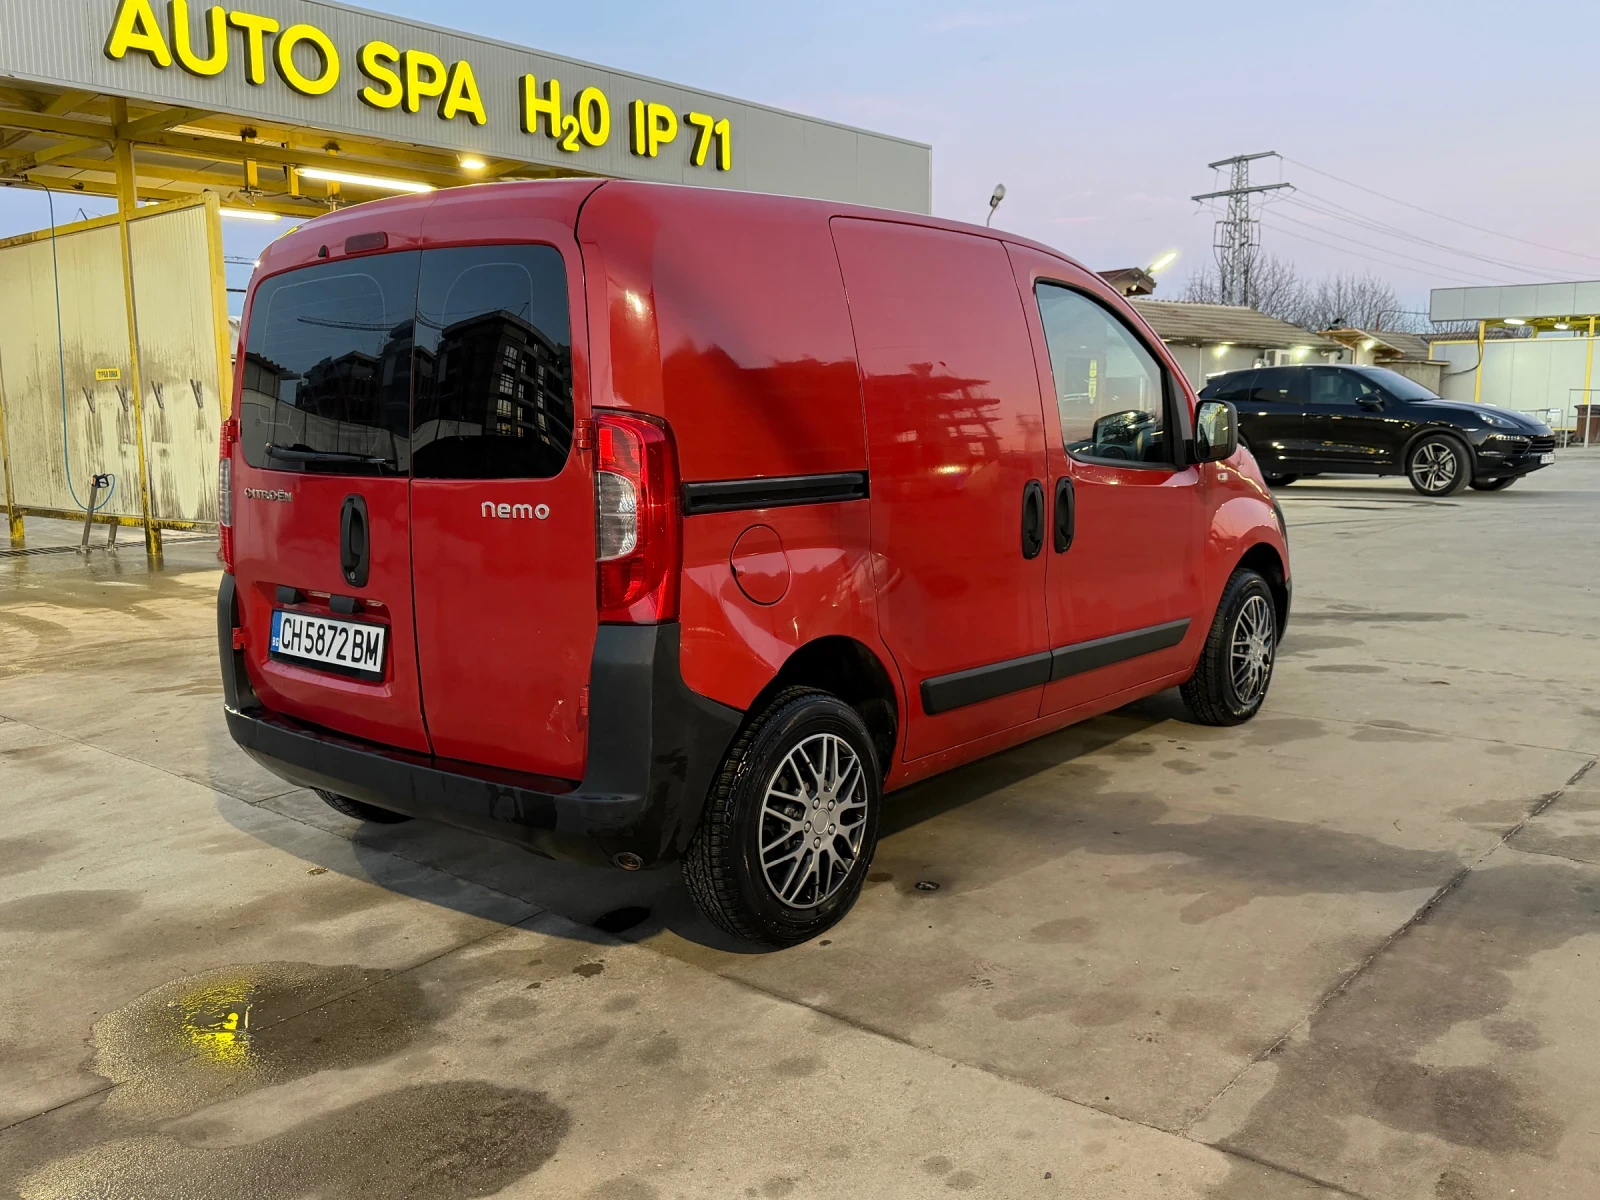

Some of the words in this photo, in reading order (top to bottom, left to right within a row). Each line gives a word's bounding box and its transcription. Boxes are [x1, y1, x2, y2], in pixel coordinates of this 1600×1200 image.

[105, 0, 340, 96] AUTO
[357, 41, 487, 125] SPA
[629, 99, 678, 157] IP
[684, 112, 731, 171] 71
[480, 500, 550, 520] nemo
